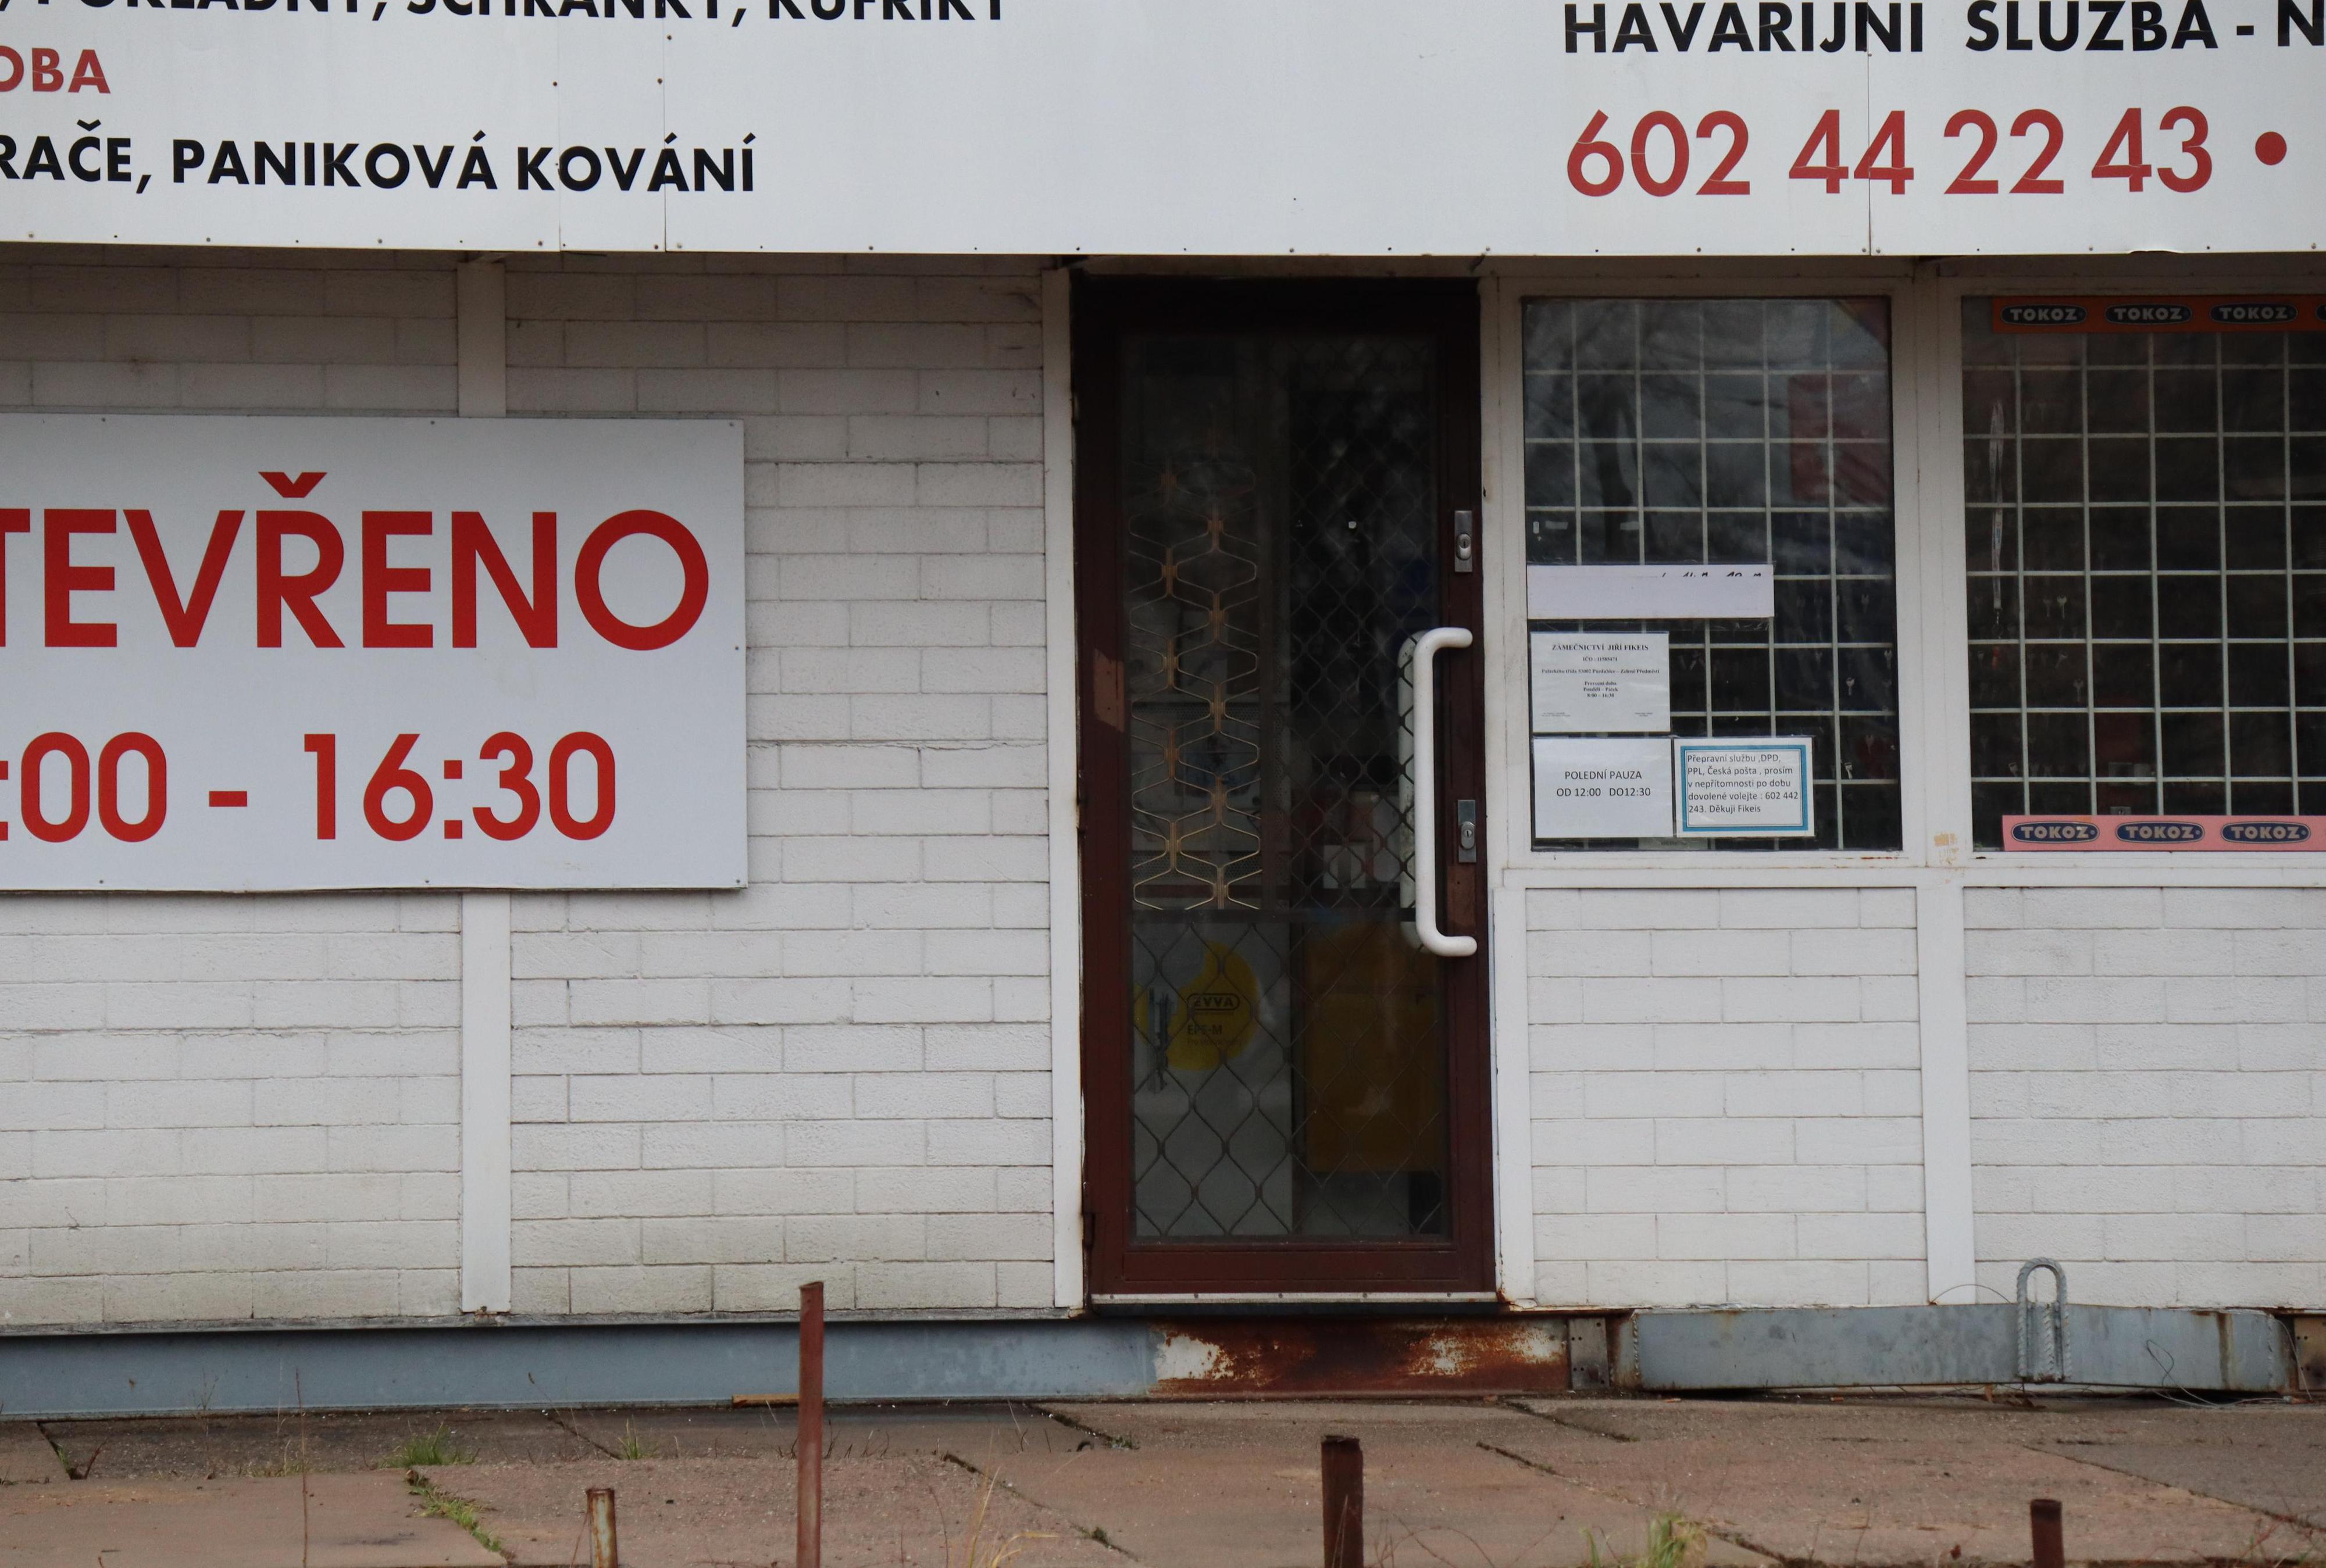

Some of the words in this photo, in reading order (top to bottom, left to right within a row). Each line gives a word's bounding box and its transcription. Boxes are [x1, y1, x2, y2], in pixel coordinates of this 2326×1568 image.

[1568, 111, 1750, 197] 602
[1789, 110, 1914, 194] 44
[1945, 110, 2064, 194] 22
[2092, 107, 2211, 192] 43
[173, 131, 498, 192] PANIKOVÁ
[518, 132, 756, 192] KOVÁNÍ
[2010, 309, 2077, 320] TOKOZ
[2114, 309, 2182, 320] TOKOZ
[2219, 308, 2288, 320] TOKOZ
[1688, 754, 1727, 764] Přepravní
[1729, 754, 1756, 762] službu
[1565, 769, 1607, 780] POLEDNÍ
[1610, 770, 1642, 780] PAUZA
[1688, 767, 1705, 776] PPL,
[1707, 765, 1732, 776] Česká
[1734, 766, 1757, 776] pošta
[1764, 767, 1793, 776] prosím
[304, 731, 616, 842] 16:30
[1694, 779, 1754, 789] nepřítomnosti
[1769, 779, 1790, 787] dobu
[1556, 788, 1572, 797] OD
[1575, 788, 1601, 796] 12:00
[1609, 787, 1651, 796] DO12:30
[1688, 792, 1727, 801] dovolené
[1729, 792, 1758, 802] volejte
[1765, 791, 1781, 800] 602
[1783, 791, 1798, 799] 442
[1689, 805, 1707, 813] 243.
[1709, 805, 1735, 814] Děkuji
[1738, 805, 1761, 813] Fikeis
[2021, 826, 2089, 839] TOKOZ
[2125, 826, 2194, 839] TOKOZ
[2231, 826, 2300, 839] TOKOZ
